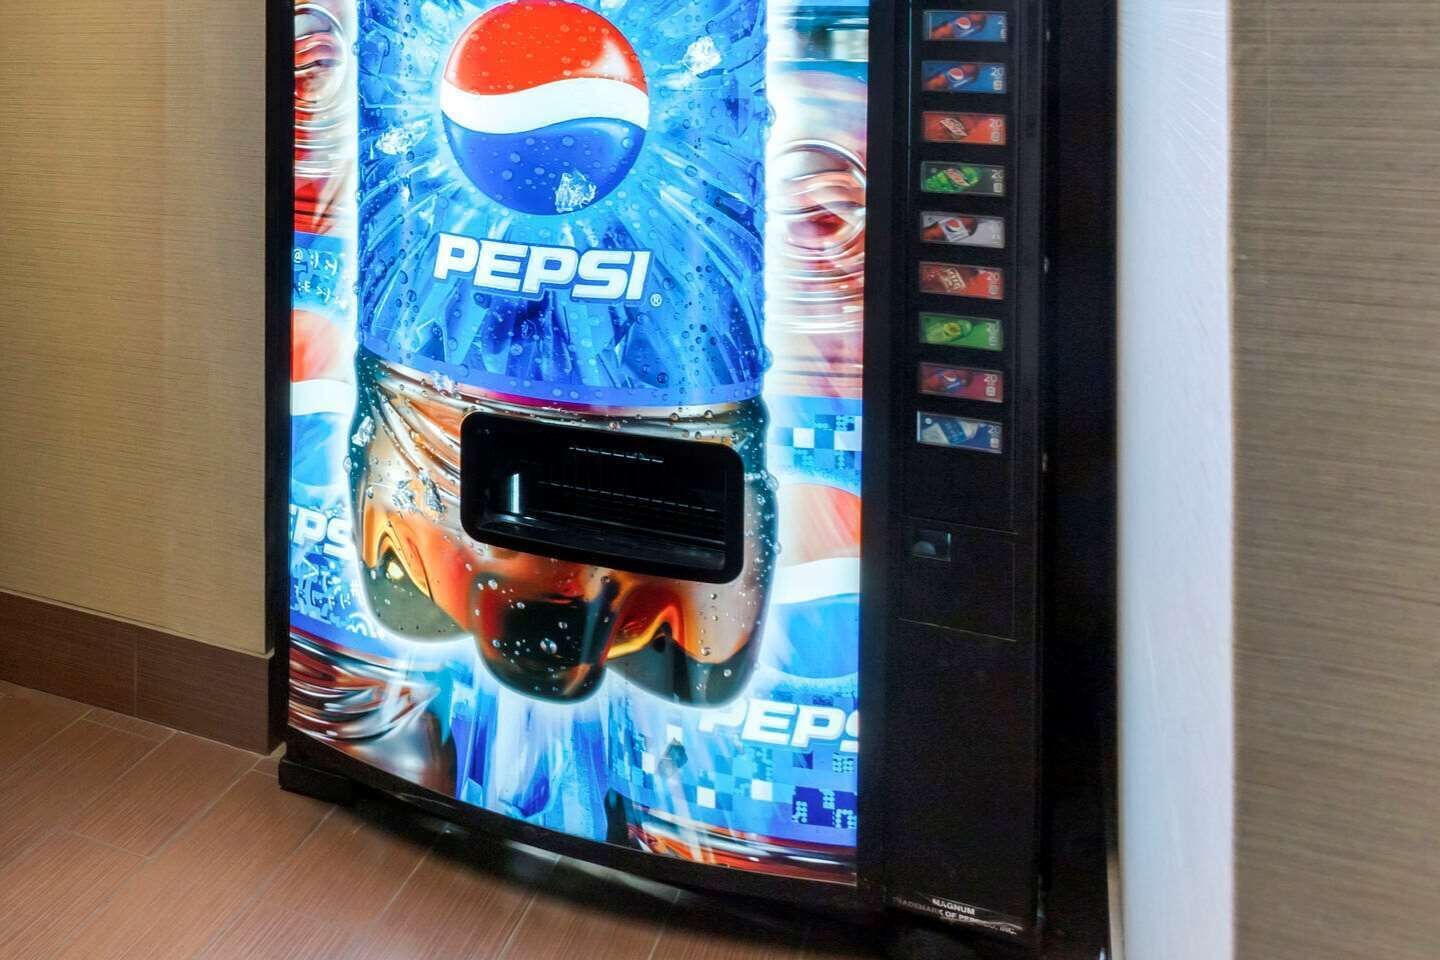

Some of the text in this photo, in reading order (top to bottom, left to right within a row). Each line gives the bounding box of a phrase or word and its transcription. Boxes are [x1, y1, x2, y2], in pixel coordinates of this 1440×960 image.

[434, 234, 651, 302] PEPSI
[982, 374, 999, 384] 20
[931, 897, 975, 916] MAGNUM
